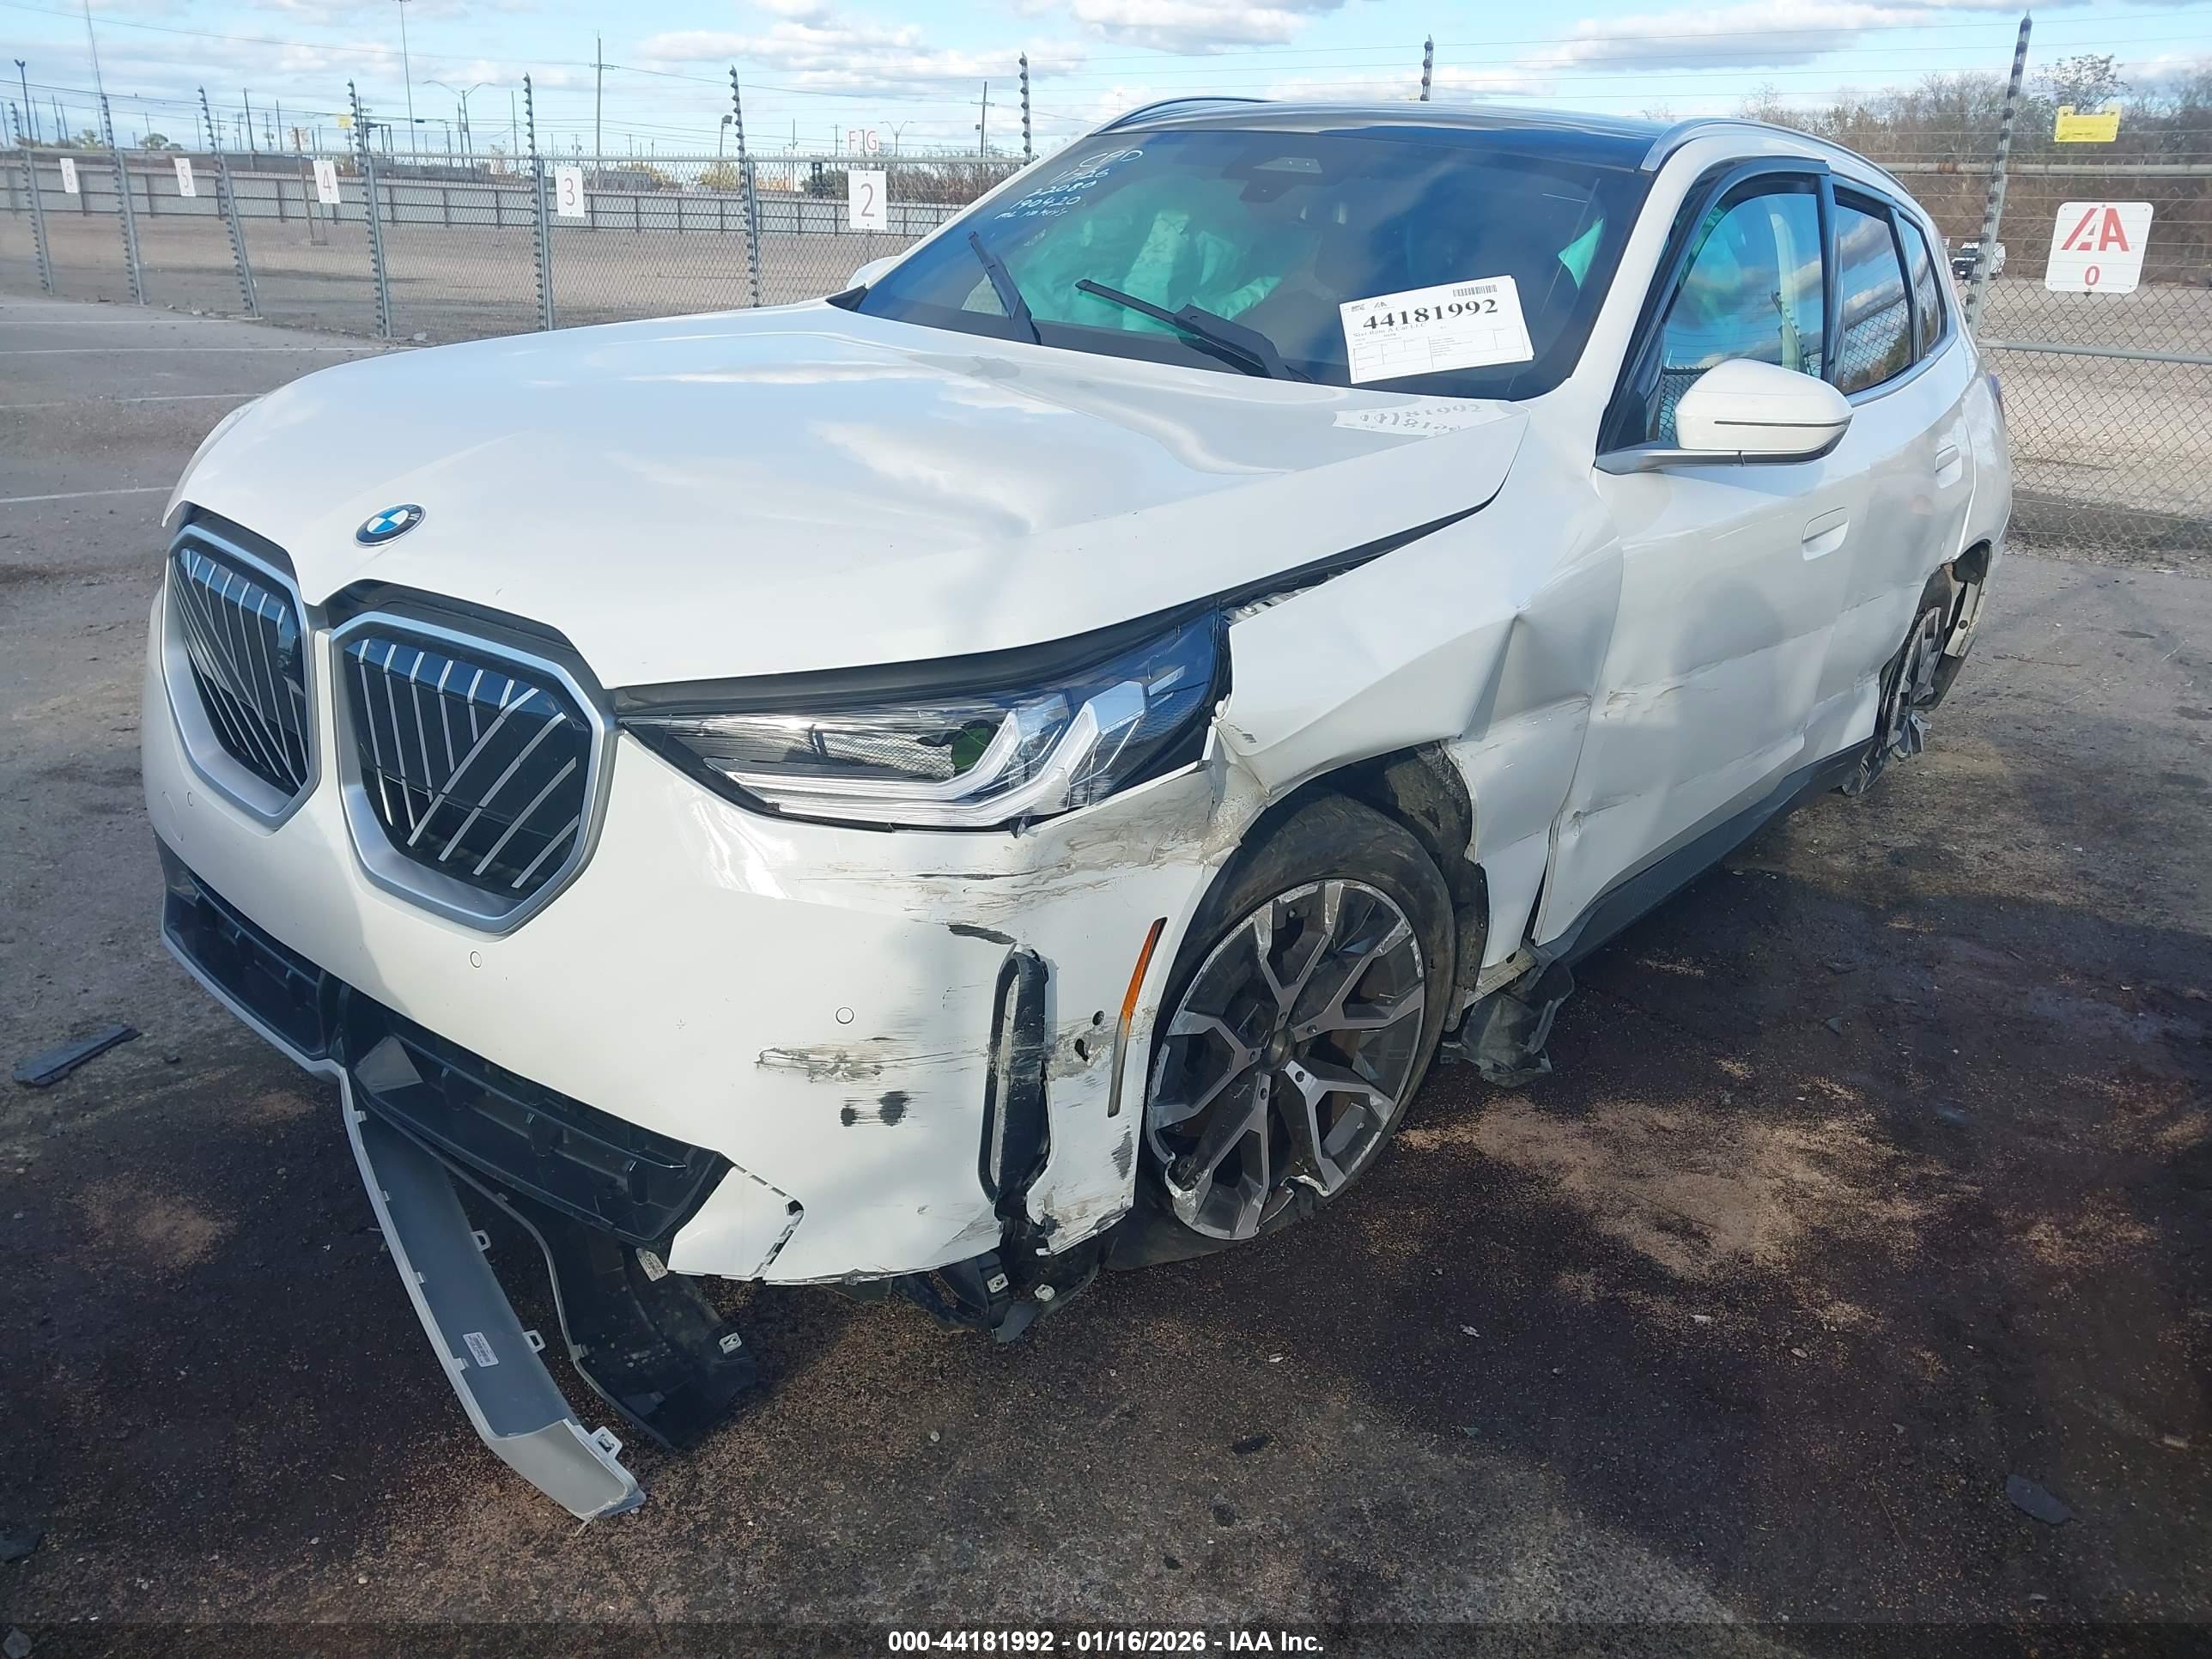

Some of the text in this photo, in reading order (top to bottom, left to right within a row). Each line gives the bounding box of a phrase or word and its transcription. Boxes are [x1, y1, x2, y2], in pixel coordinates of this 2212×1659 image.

[848, 131, 877, 150] F G
[66, 165, 73, 186] 6
[180, 167, 189, 188] 5
[323, 169, 331, 194] 4
[564, 177, 575, 206] 3
[860, 183, 875, 217] 2
[1363, 299, 1498, 330] 44181992
